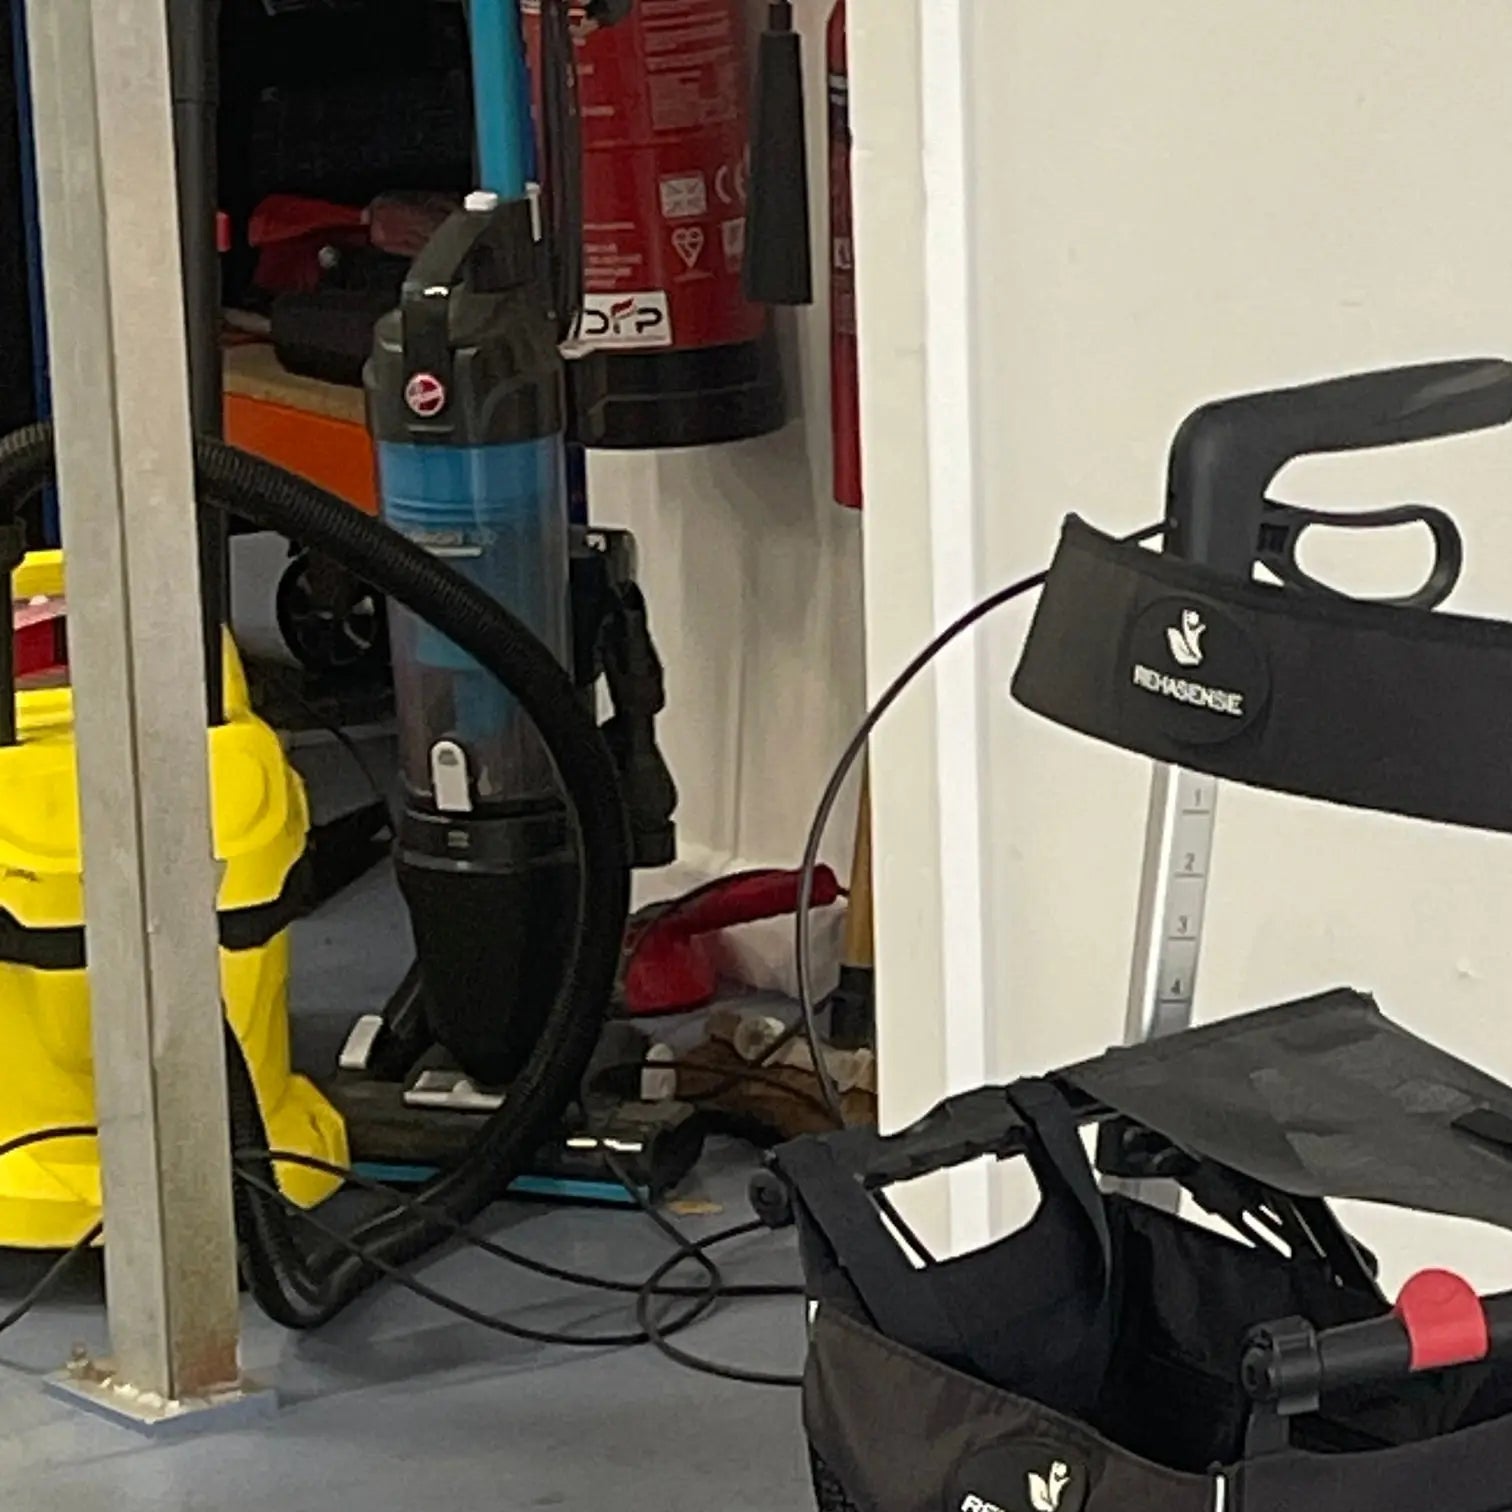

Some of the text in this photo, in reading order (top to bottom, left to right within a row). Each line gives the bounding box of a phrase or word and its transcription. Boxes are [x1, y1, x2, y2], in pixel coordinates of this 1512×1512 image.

[1133, 664, 1244, 716] REHASENSE
[1184, 853, 1196, 871] 2
[1177, 916, 1189, 933] 3
[1170, 978, 1182, 995] 4
